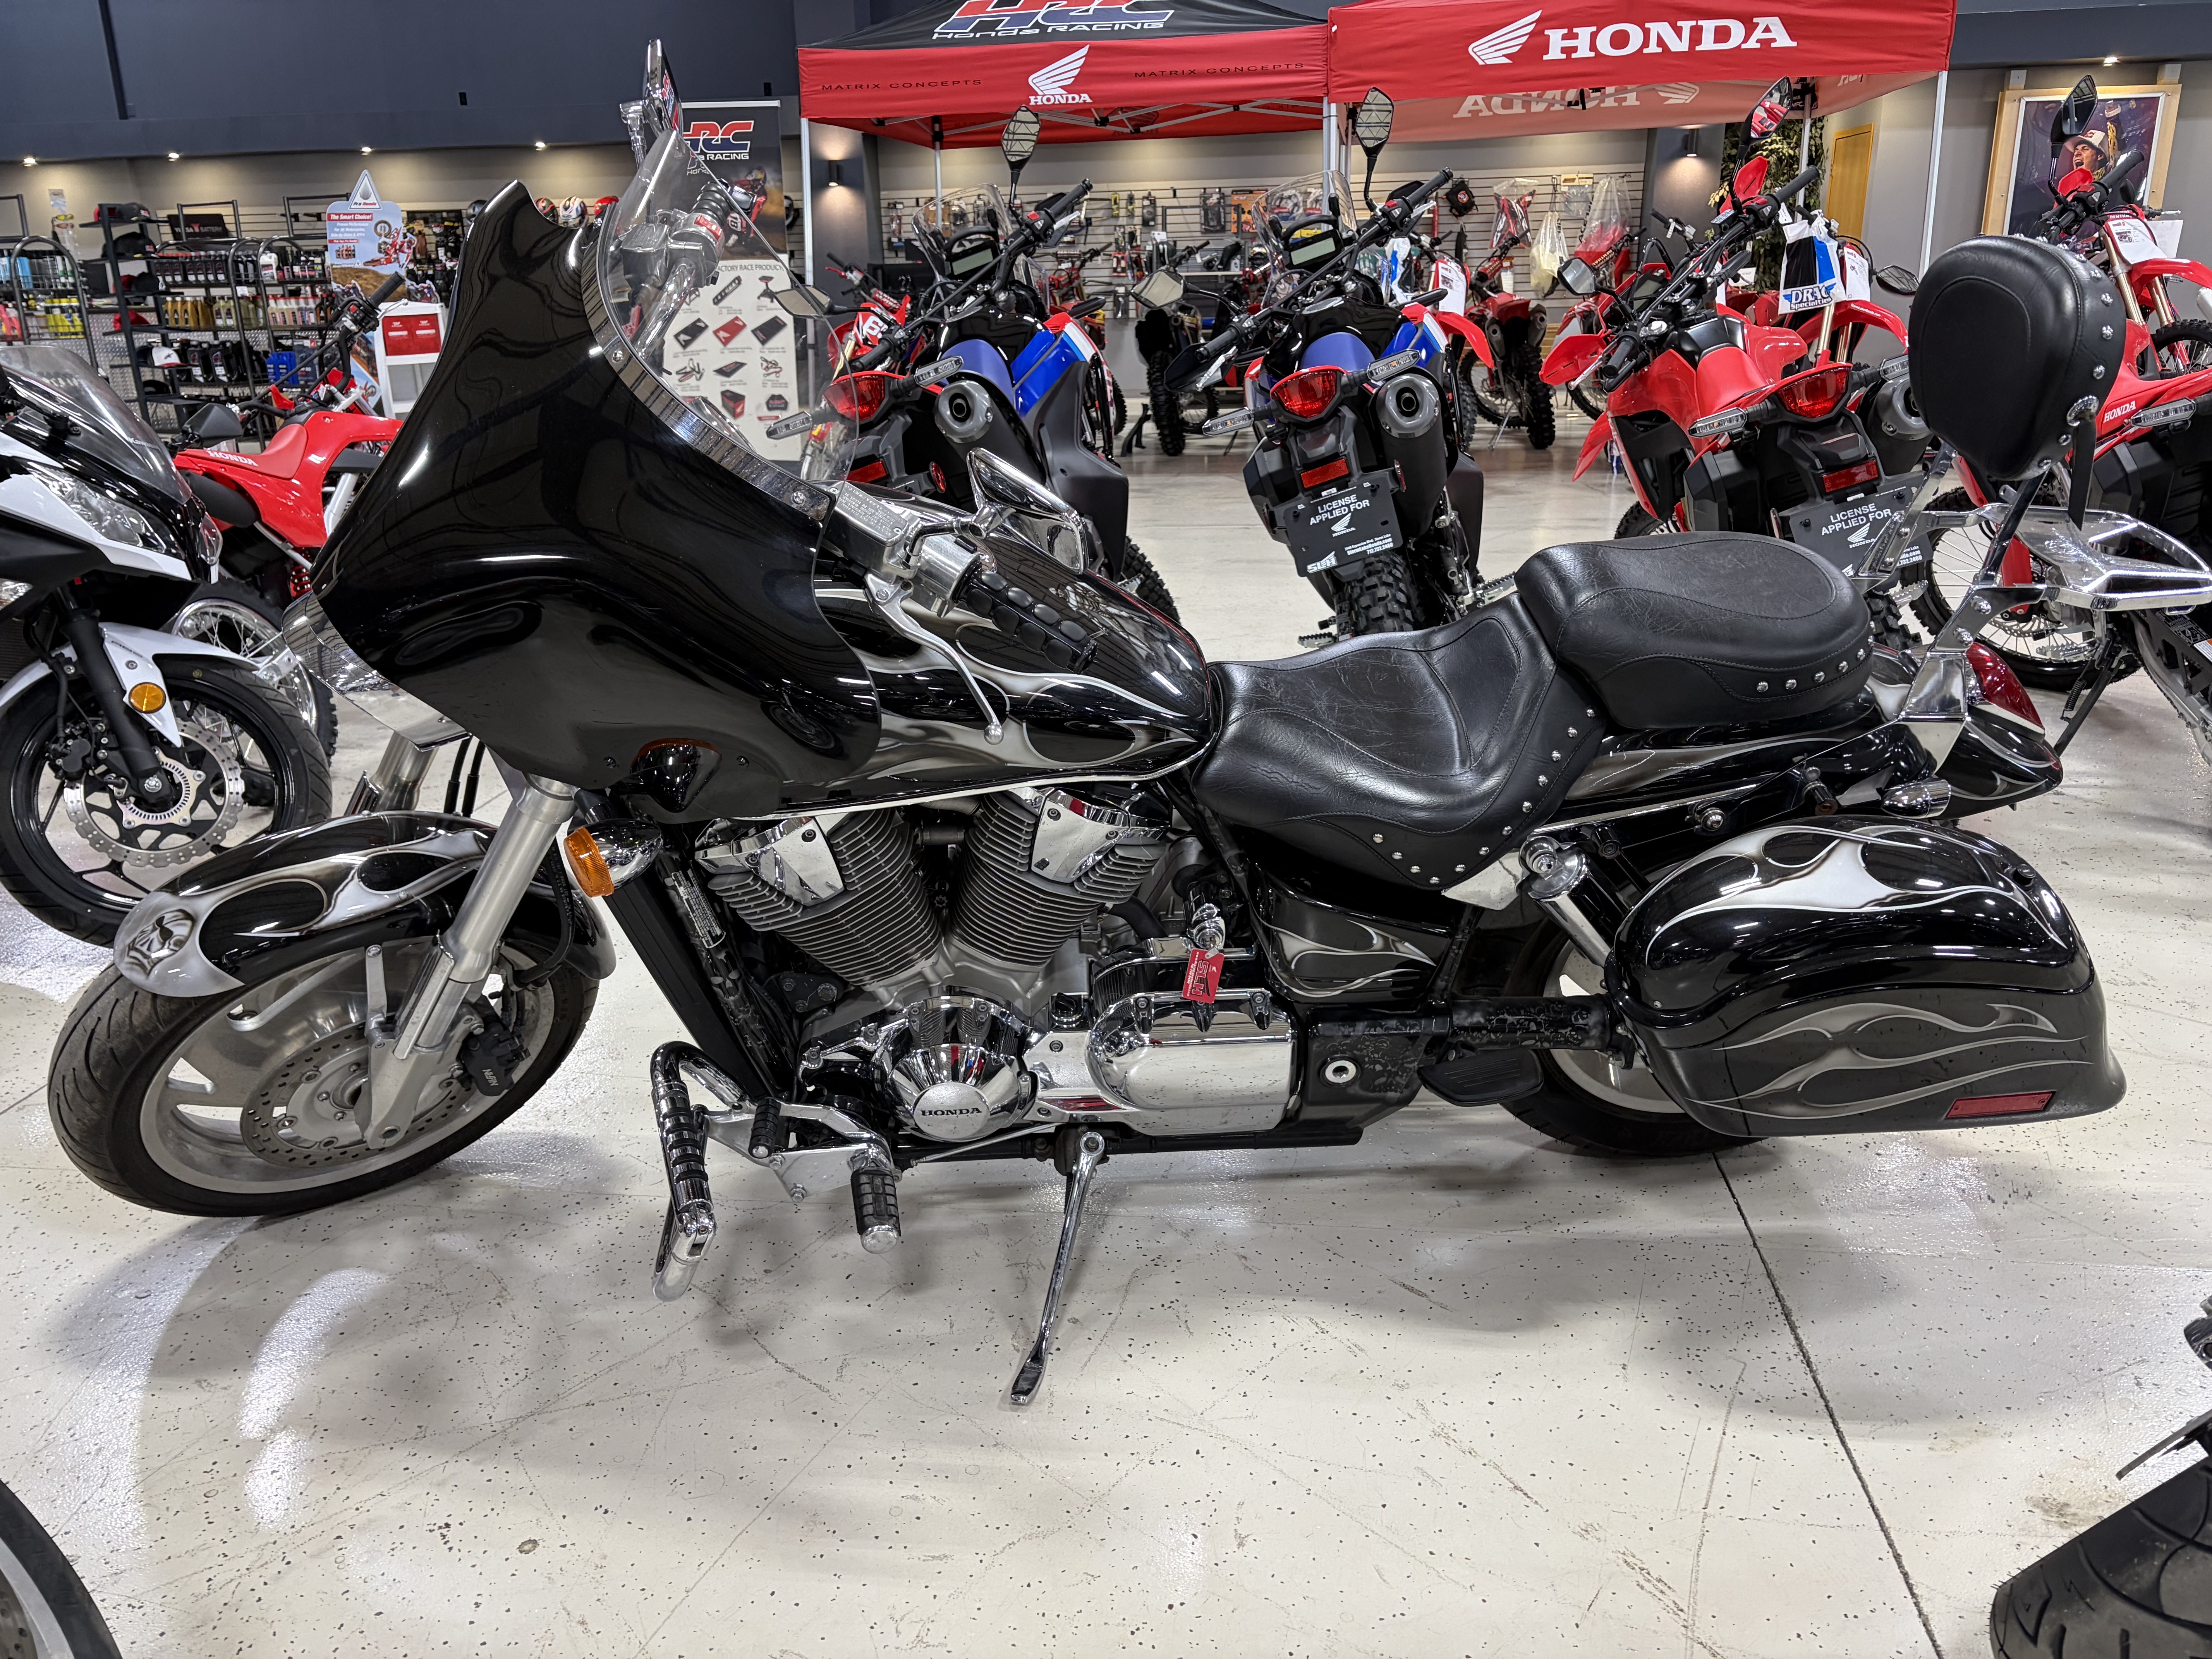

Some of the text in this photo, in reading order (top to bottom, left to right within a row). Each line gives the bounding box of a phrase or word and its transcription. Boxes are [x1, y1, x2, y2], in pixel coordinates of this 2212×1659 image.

[932, 22, 1164, 39] Honda RACING
[1542, 16, 1797, 60] HONDA
[1135, 63, 1304, 78] MATRIX CONCEPTS
[889, 79, 982, 89] CONCEPTS
[1029, 93, 1092, 105] HONDA
[1790, 297, 1832, 310] Specialties
[2103, 400, 2136, 423] HONDA
[206, 450, 259, 467] HONDA
[1310, 499, 1370, 525] APPLIED FOR
[1317, 494, 1357, 514] LICENSE
[1830, 503, 1877, 523] LICENSE
[1822, 508, 1892, 536] APPLIED FOR
[1332, 527, 1356, 537] HONDA
[1849, 538, 1876, 548] HONDA
[1191, 959, 1209, 996] SLH
[920, 1108, 982, 1116] HONDA
